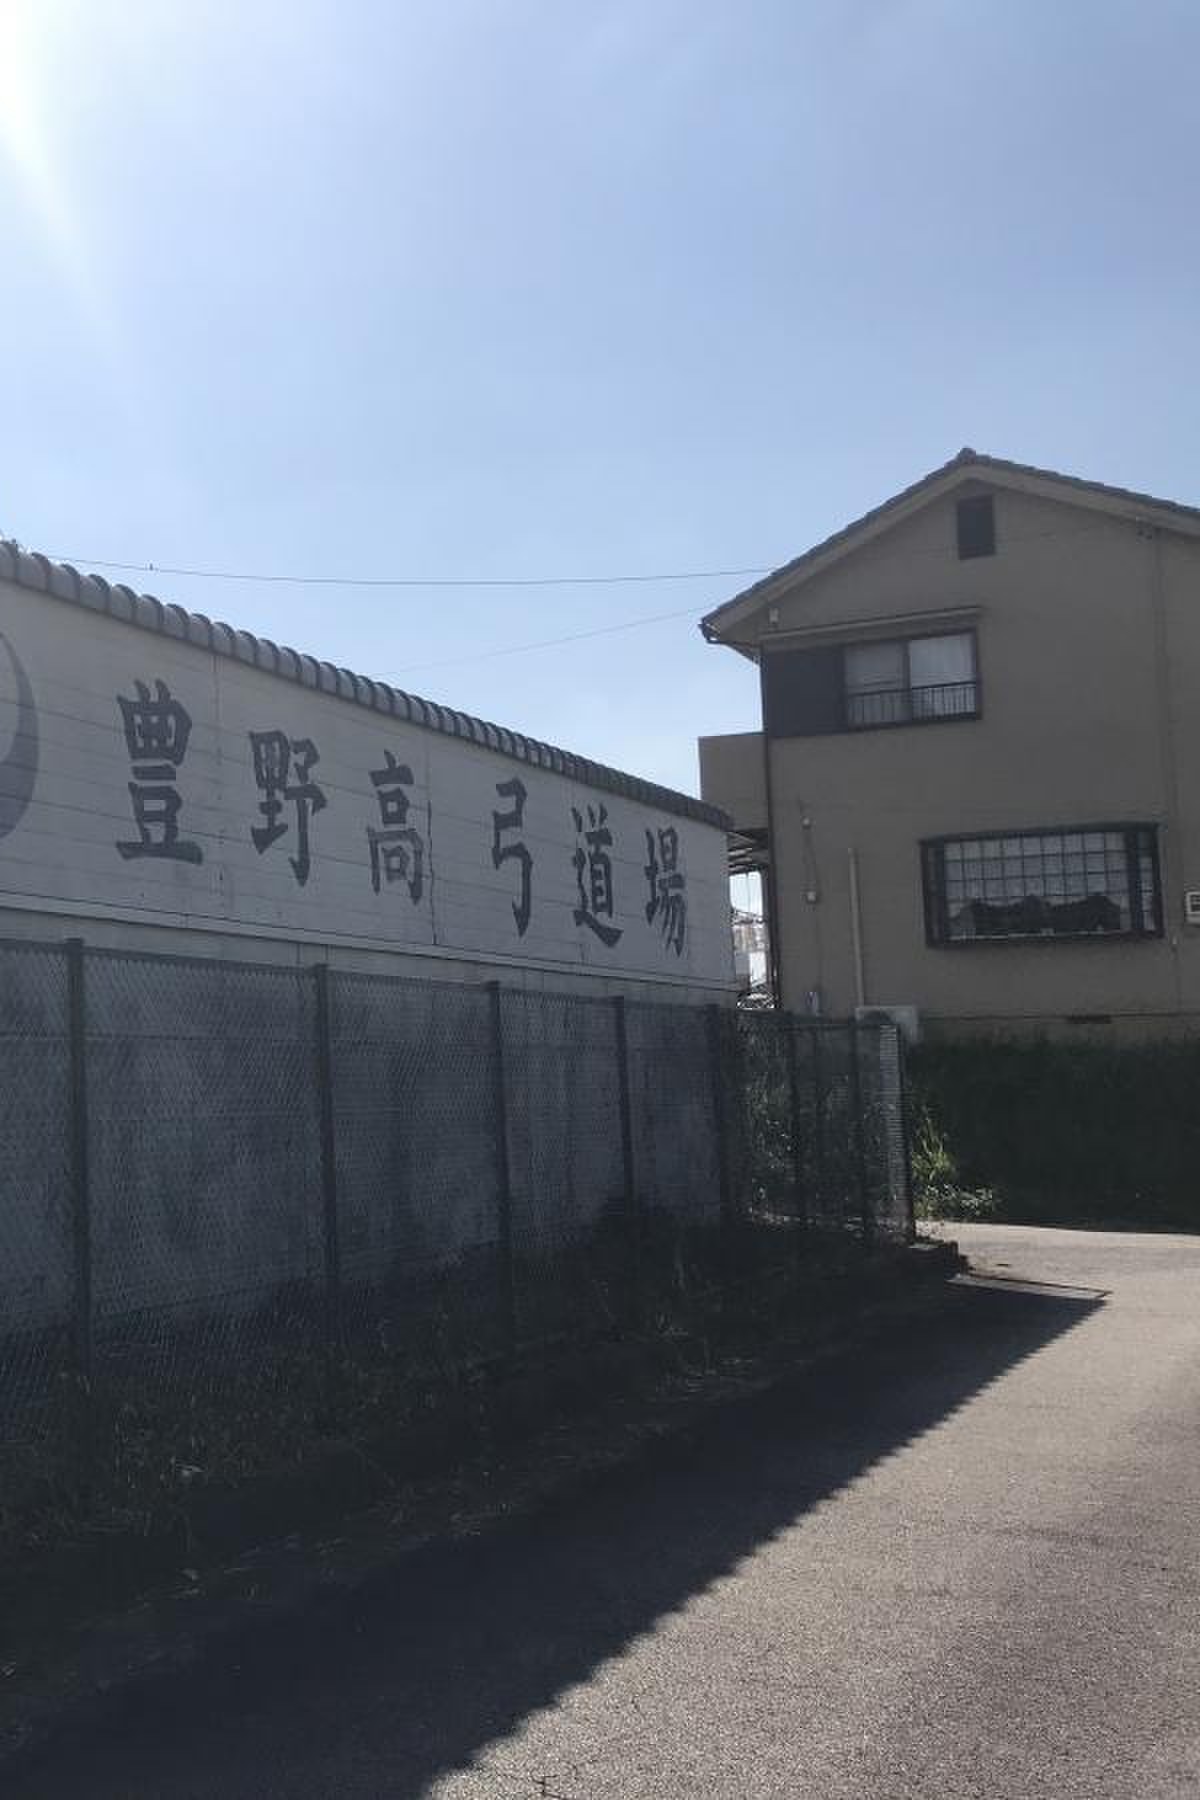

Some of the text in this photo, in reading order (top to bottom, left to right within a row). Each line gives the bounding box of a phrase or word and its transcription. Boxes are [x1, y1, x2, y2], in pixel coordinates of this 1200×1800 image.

[116, 679, 686, 957] 豊野高弓道場
